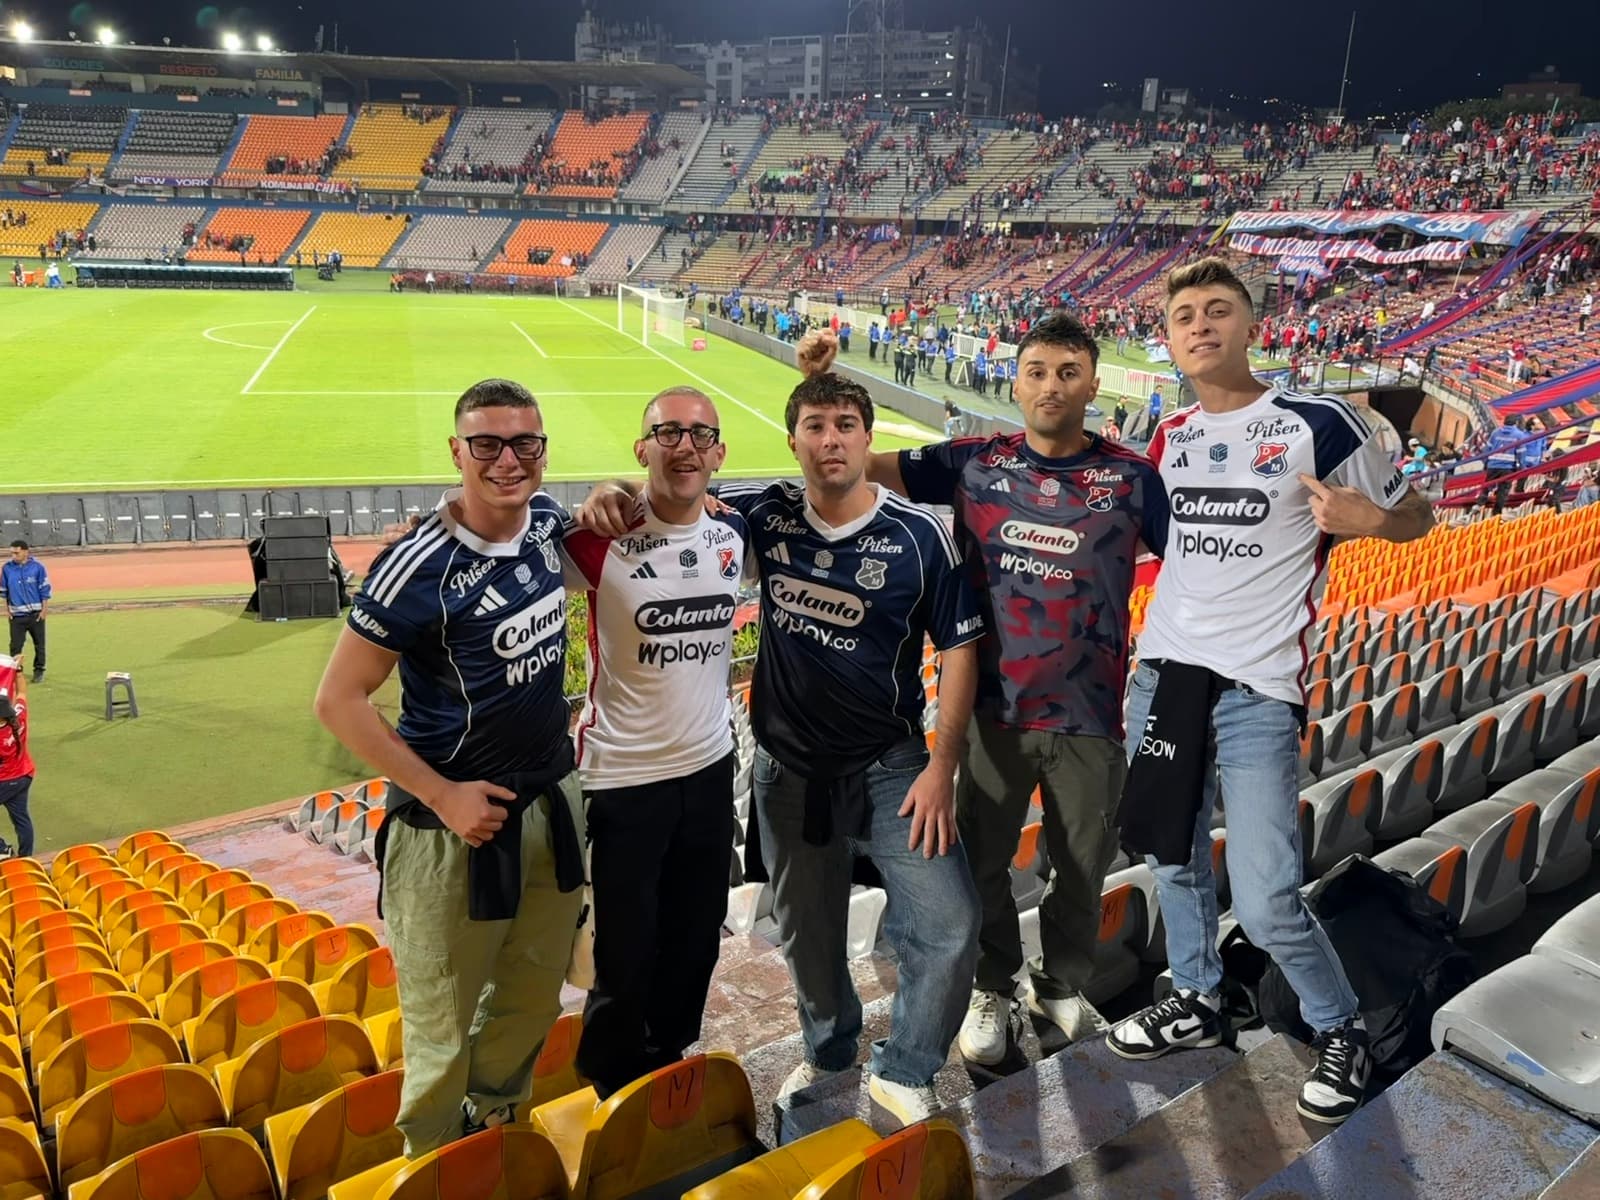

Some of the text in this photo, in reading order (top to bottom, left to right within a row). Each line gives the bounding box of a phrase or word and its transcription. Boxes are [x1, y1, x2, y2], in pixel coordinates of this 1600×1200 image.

[160, 64, 218, 76] RESPETO
[255, 68, 303, 81] FAMILIA
[133, 175, 209, 187] NEW YORK
[1229, 232, 1258, 253] LOX
[1325, 240, 1357, 258] EN
[1168, 429, 1205, 446] Pilsen
[1245, 420, 1301, 441] Pilsen
[990, 455, 1027, 469] Pilsen
[1083, 468, 1123, 483] Pilsen
[1172, 493, 1266, 518] Colanta
[526, 516, 557, 548] Pilsen
[763, 514, 807, 535] Pilsen
[620, 537, 669, 556] Pilsen
[703, 529, 735, 549] Pilsen
[856, 535, 903, 554] Pilsen
[1002, 525, 1076, 549] Colanta
[1000, 553, 1073, 580] Wplay.co
[450, 557, 497, 598] Pilsen
[769, 578, 860, 622] Colanta
[637, 603, 735, 628] Colanta
[668, 1068, 697, 1110] M
